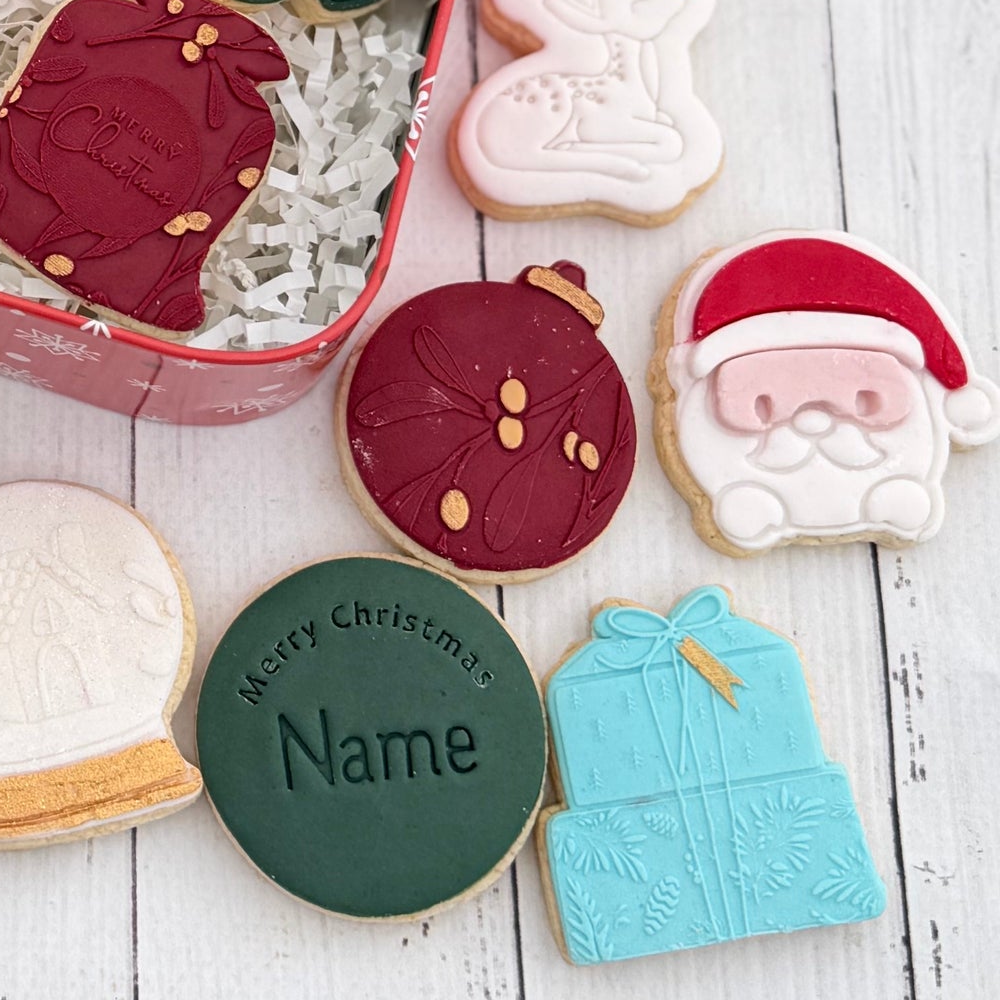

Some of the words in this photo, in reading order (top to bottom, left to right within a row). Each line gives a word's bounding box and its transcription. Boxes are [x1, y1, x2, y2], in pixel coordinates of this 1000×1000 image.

[109, 106, 185, 160] MERRY
[238, 620, 317, 706] Merry
[331, 601, 494, 689] Christmas
[277, 708, 478, 791] Name
